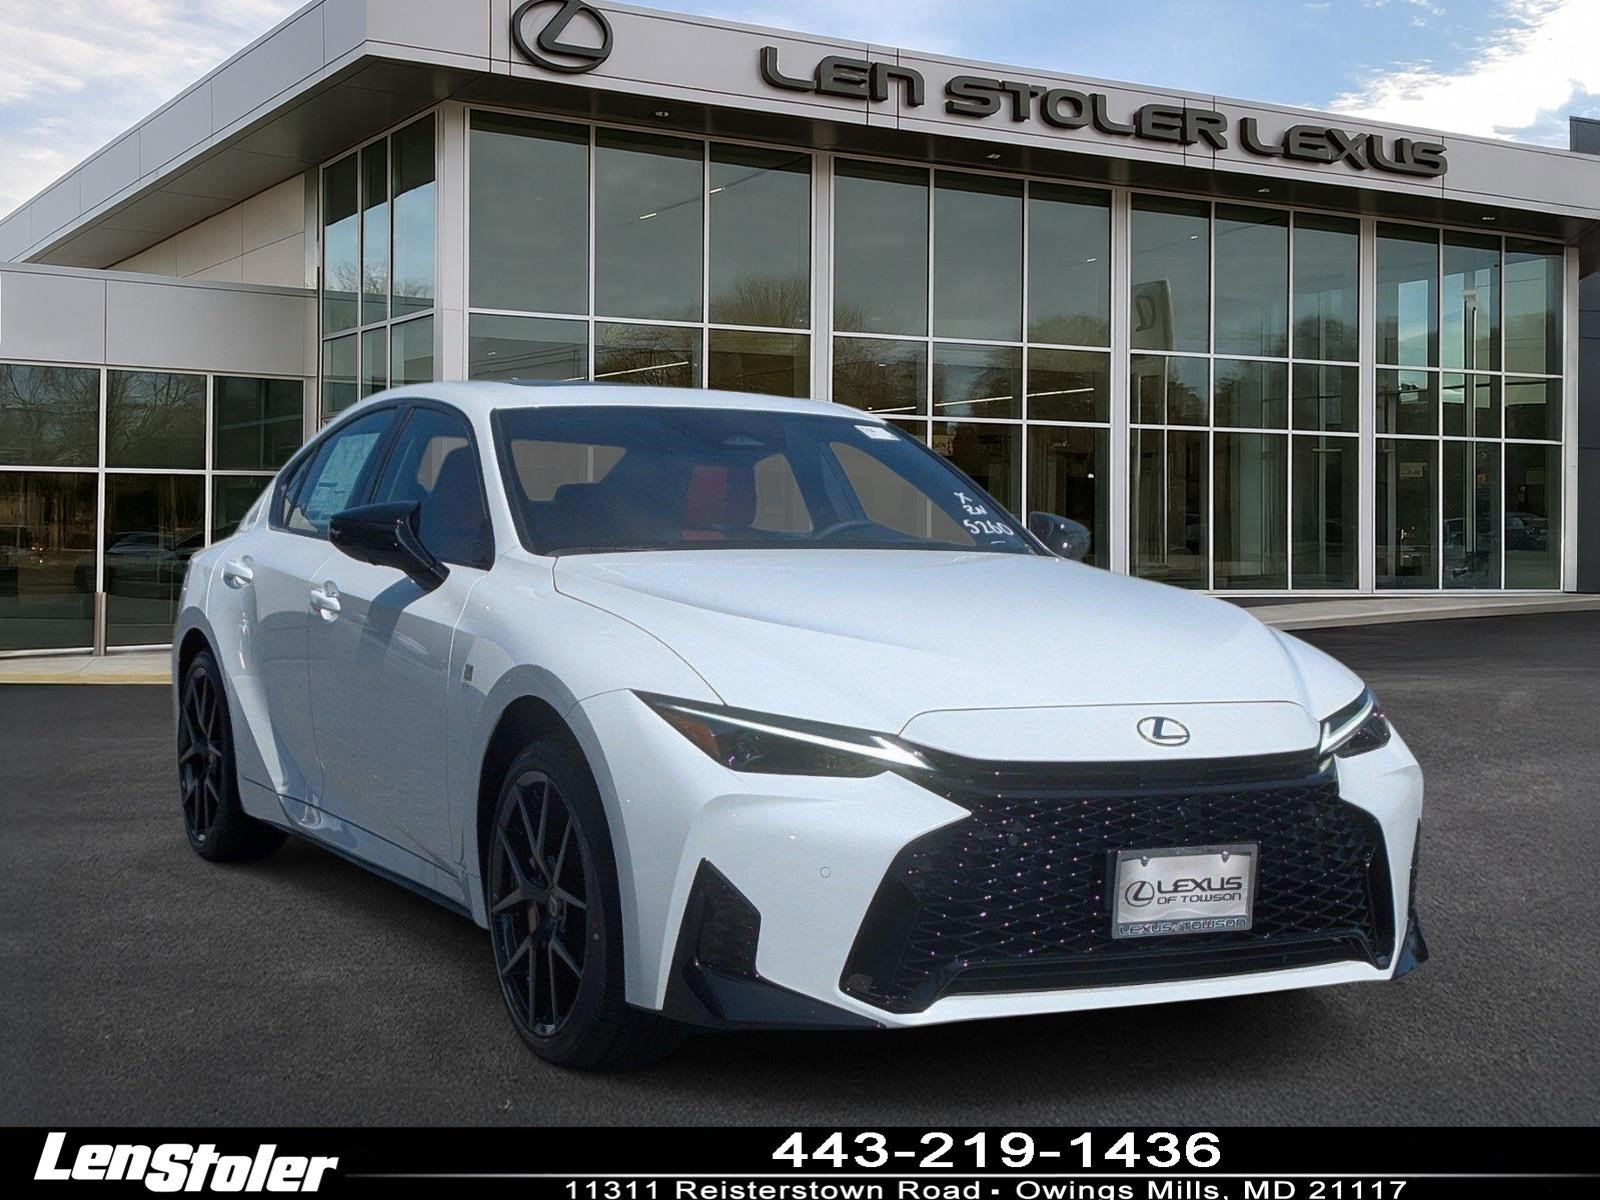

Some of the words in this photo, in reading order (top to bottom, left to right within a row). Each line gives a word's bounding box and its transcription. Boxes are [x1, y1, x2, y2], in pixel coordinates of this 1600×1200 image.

[759, 46, 925, 106] LEN
[945, 75, 1229, 150] STOLER
[1240, 117, 1448, 178] LEXUS
[1157, 876, 1242, 894] LEXUS
[1157, 896, 1178, 905] OF
[1181, 892, 1242, 904] TOWSON
[1119, 922, 1172, 936] LEXUS
